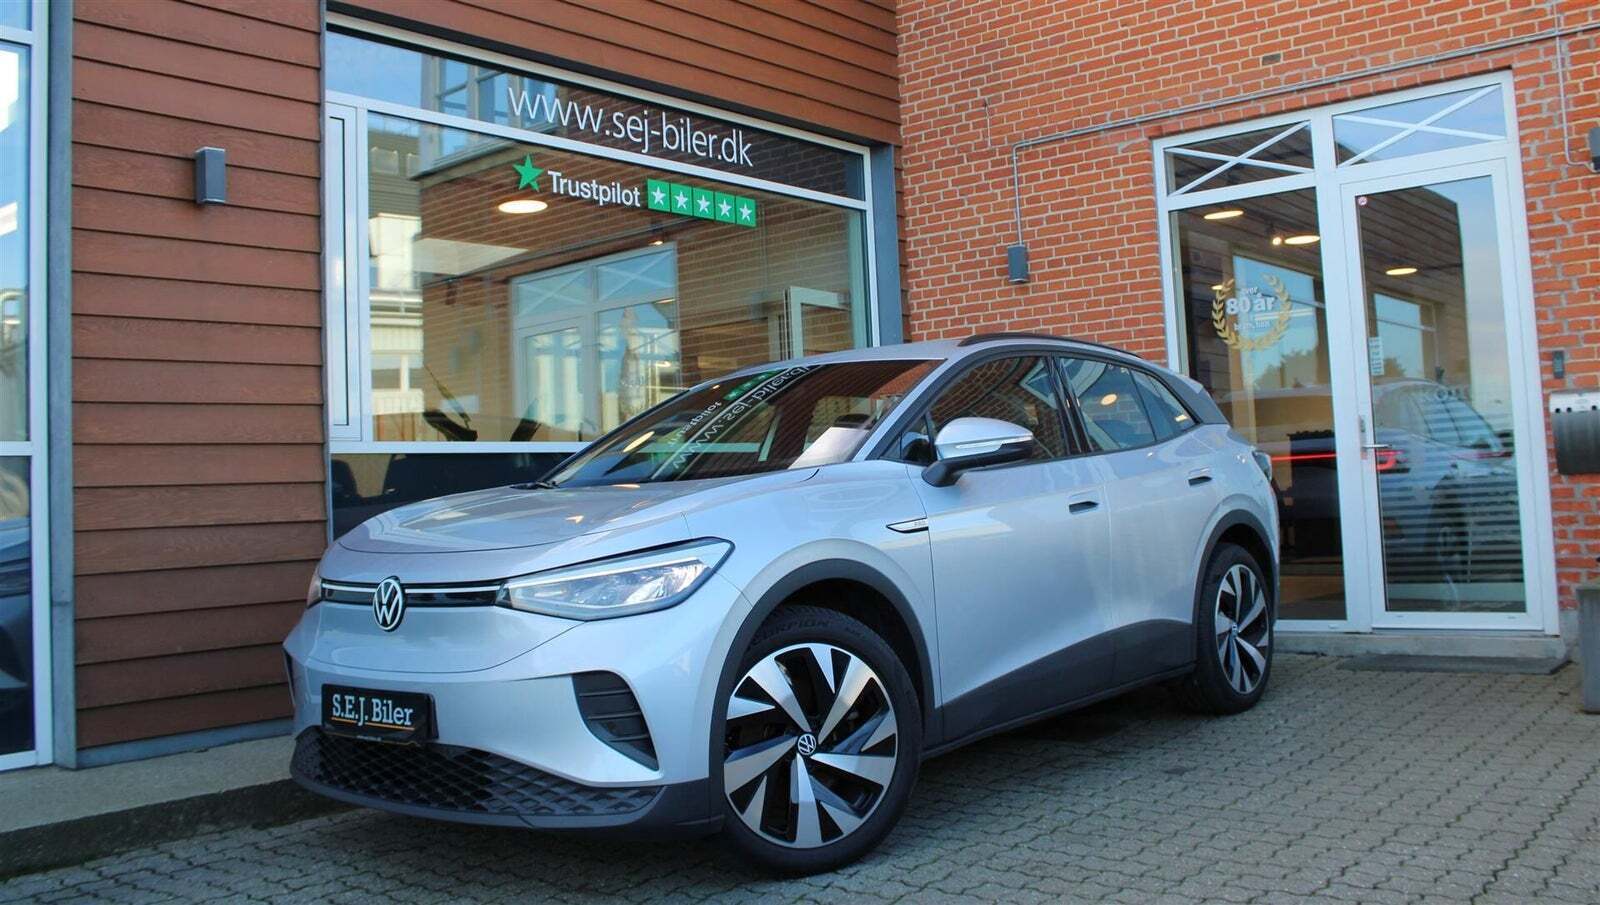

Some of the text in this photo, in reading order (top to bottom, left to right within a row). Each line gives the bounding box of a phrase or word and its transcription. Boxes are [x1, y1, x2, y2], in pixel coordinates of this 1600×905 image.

[508, 87, 753, 166] www.sej-biler.dk
[547, 170, 641, 207] Trustpilot
[1226, 293, 1275, 315] 80 år
[332, 694, 413, 726] S.E.J. Biler
